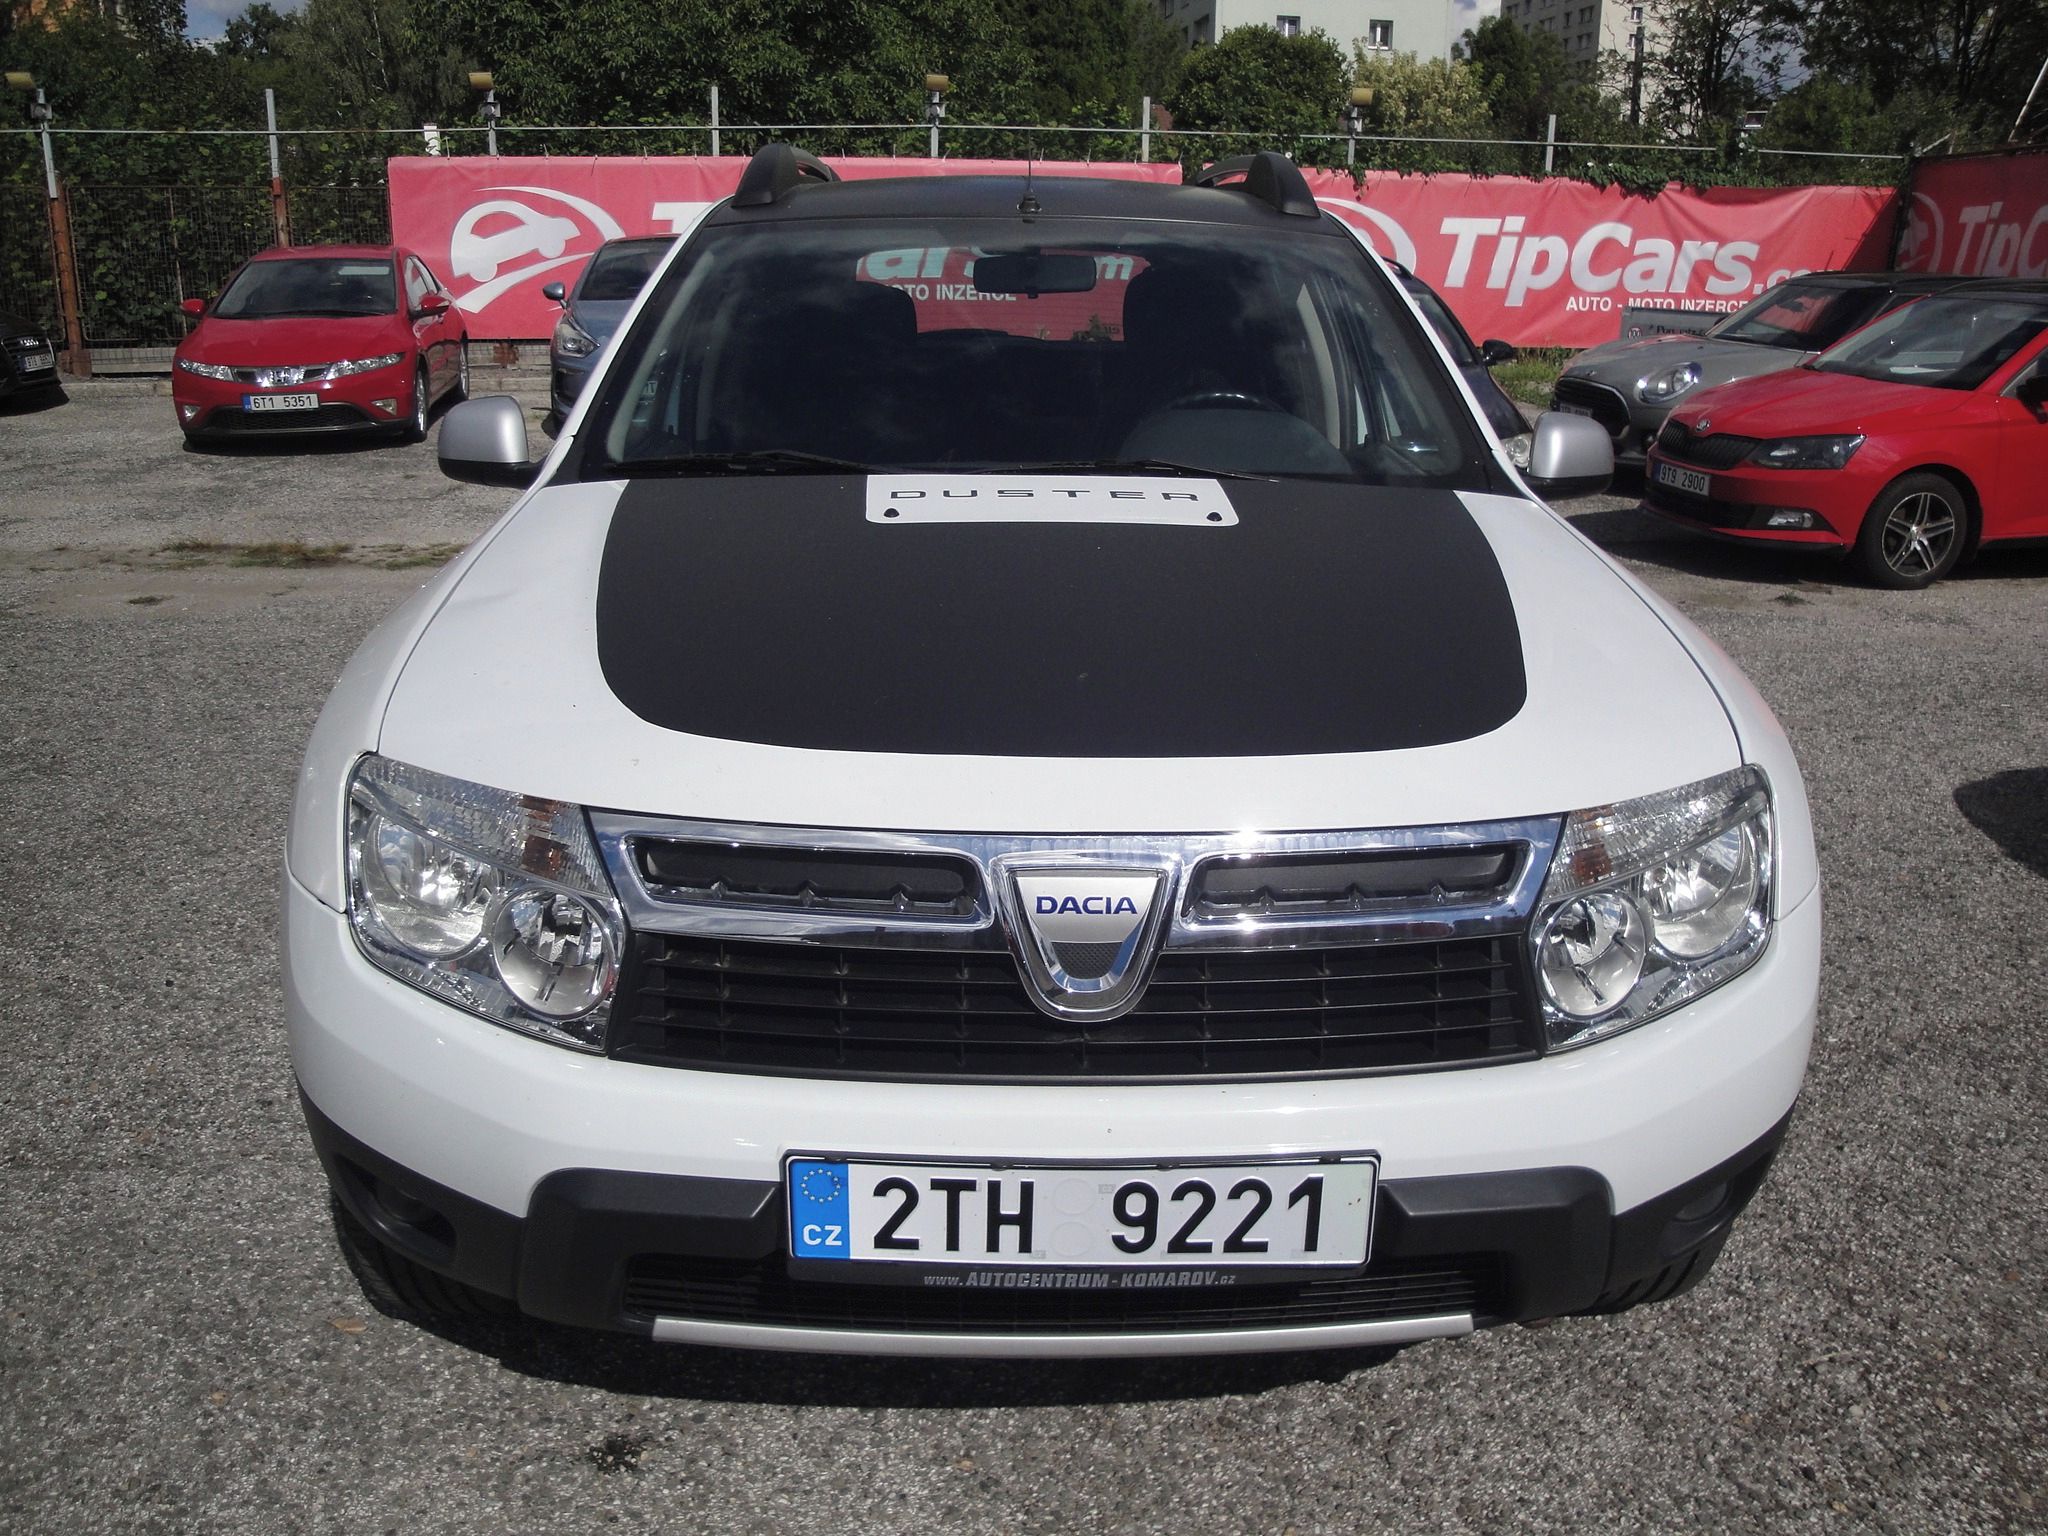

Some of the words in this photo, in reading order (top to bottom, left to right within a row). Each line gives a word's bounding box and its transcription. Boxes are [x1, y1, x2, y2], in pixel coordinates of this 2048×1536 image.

[1565, 296, 1612, 312] AUTO
[253, 397, 275, 409] 6T1
[283, 396, 313, 408] 5351
[890, 489, 1199, 501] DUSTER
[1036, 896, 1138, 915] DACIA
[873, 1176, 1035, 1254] 2TH
[1111, 1175, 1325, 1254] 9221
[803, 1223, 843, 1246] CZ
